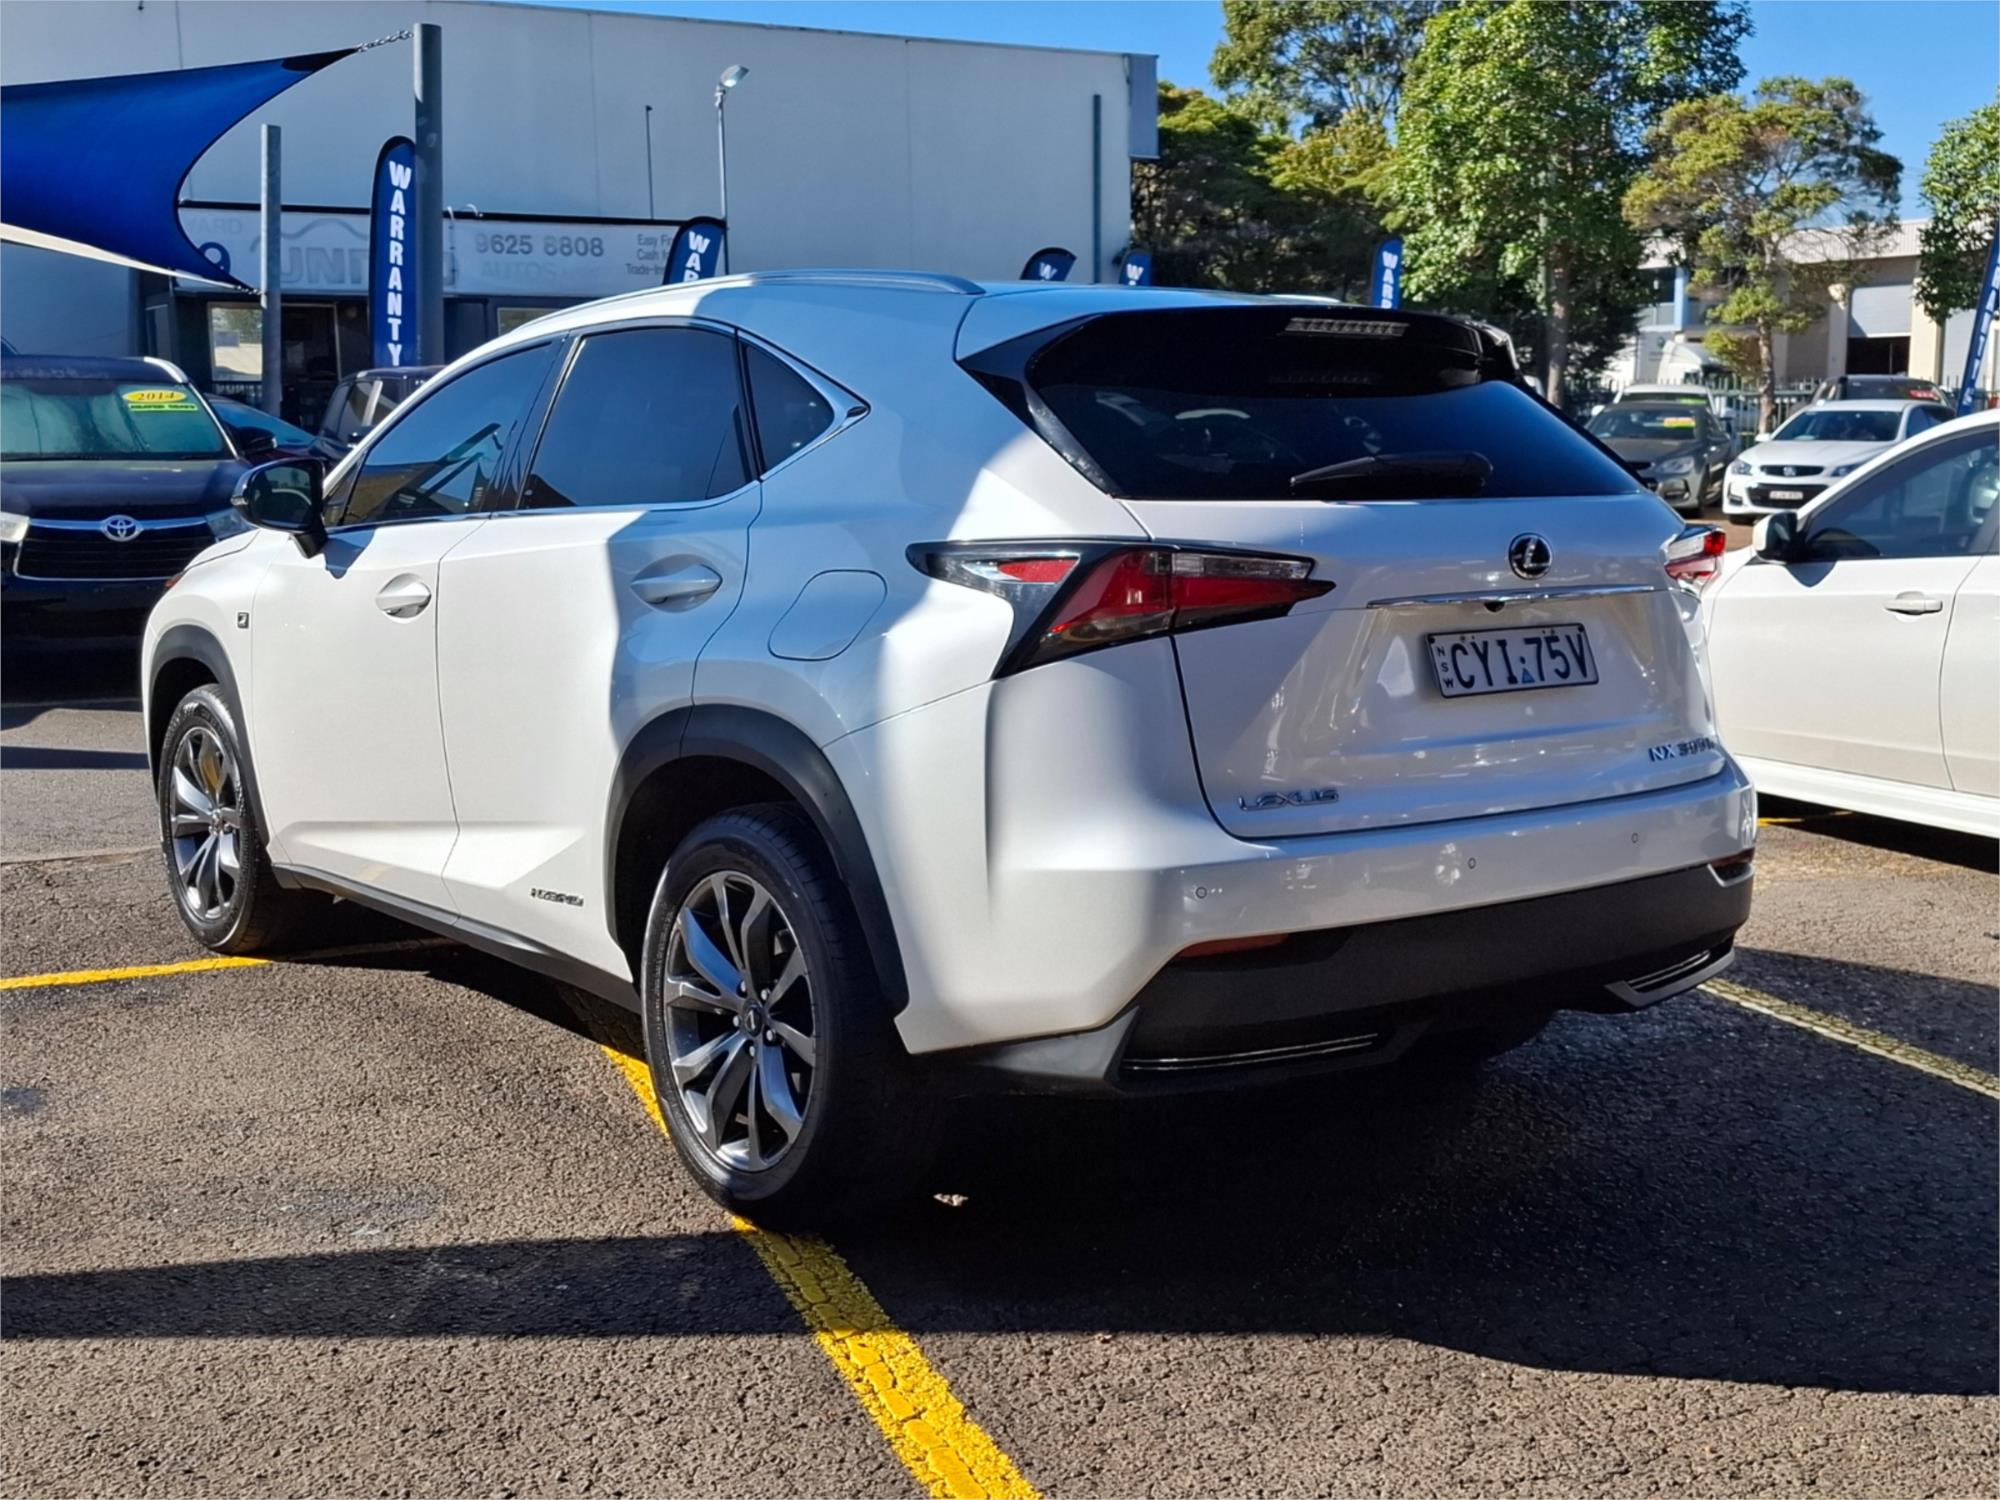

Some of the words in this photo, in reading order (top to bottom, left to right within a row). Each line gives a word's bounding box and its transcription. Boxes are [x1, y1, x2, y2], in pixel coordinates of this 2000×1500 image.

[474, 233, 533, 255] 9625
[543, 235, 604, 257] 8808
[388, 161, 412, 366] WARRANTY
[1648, 744, 1675, 762] NX
[1237, 786, 1339, 812] LEXUS
